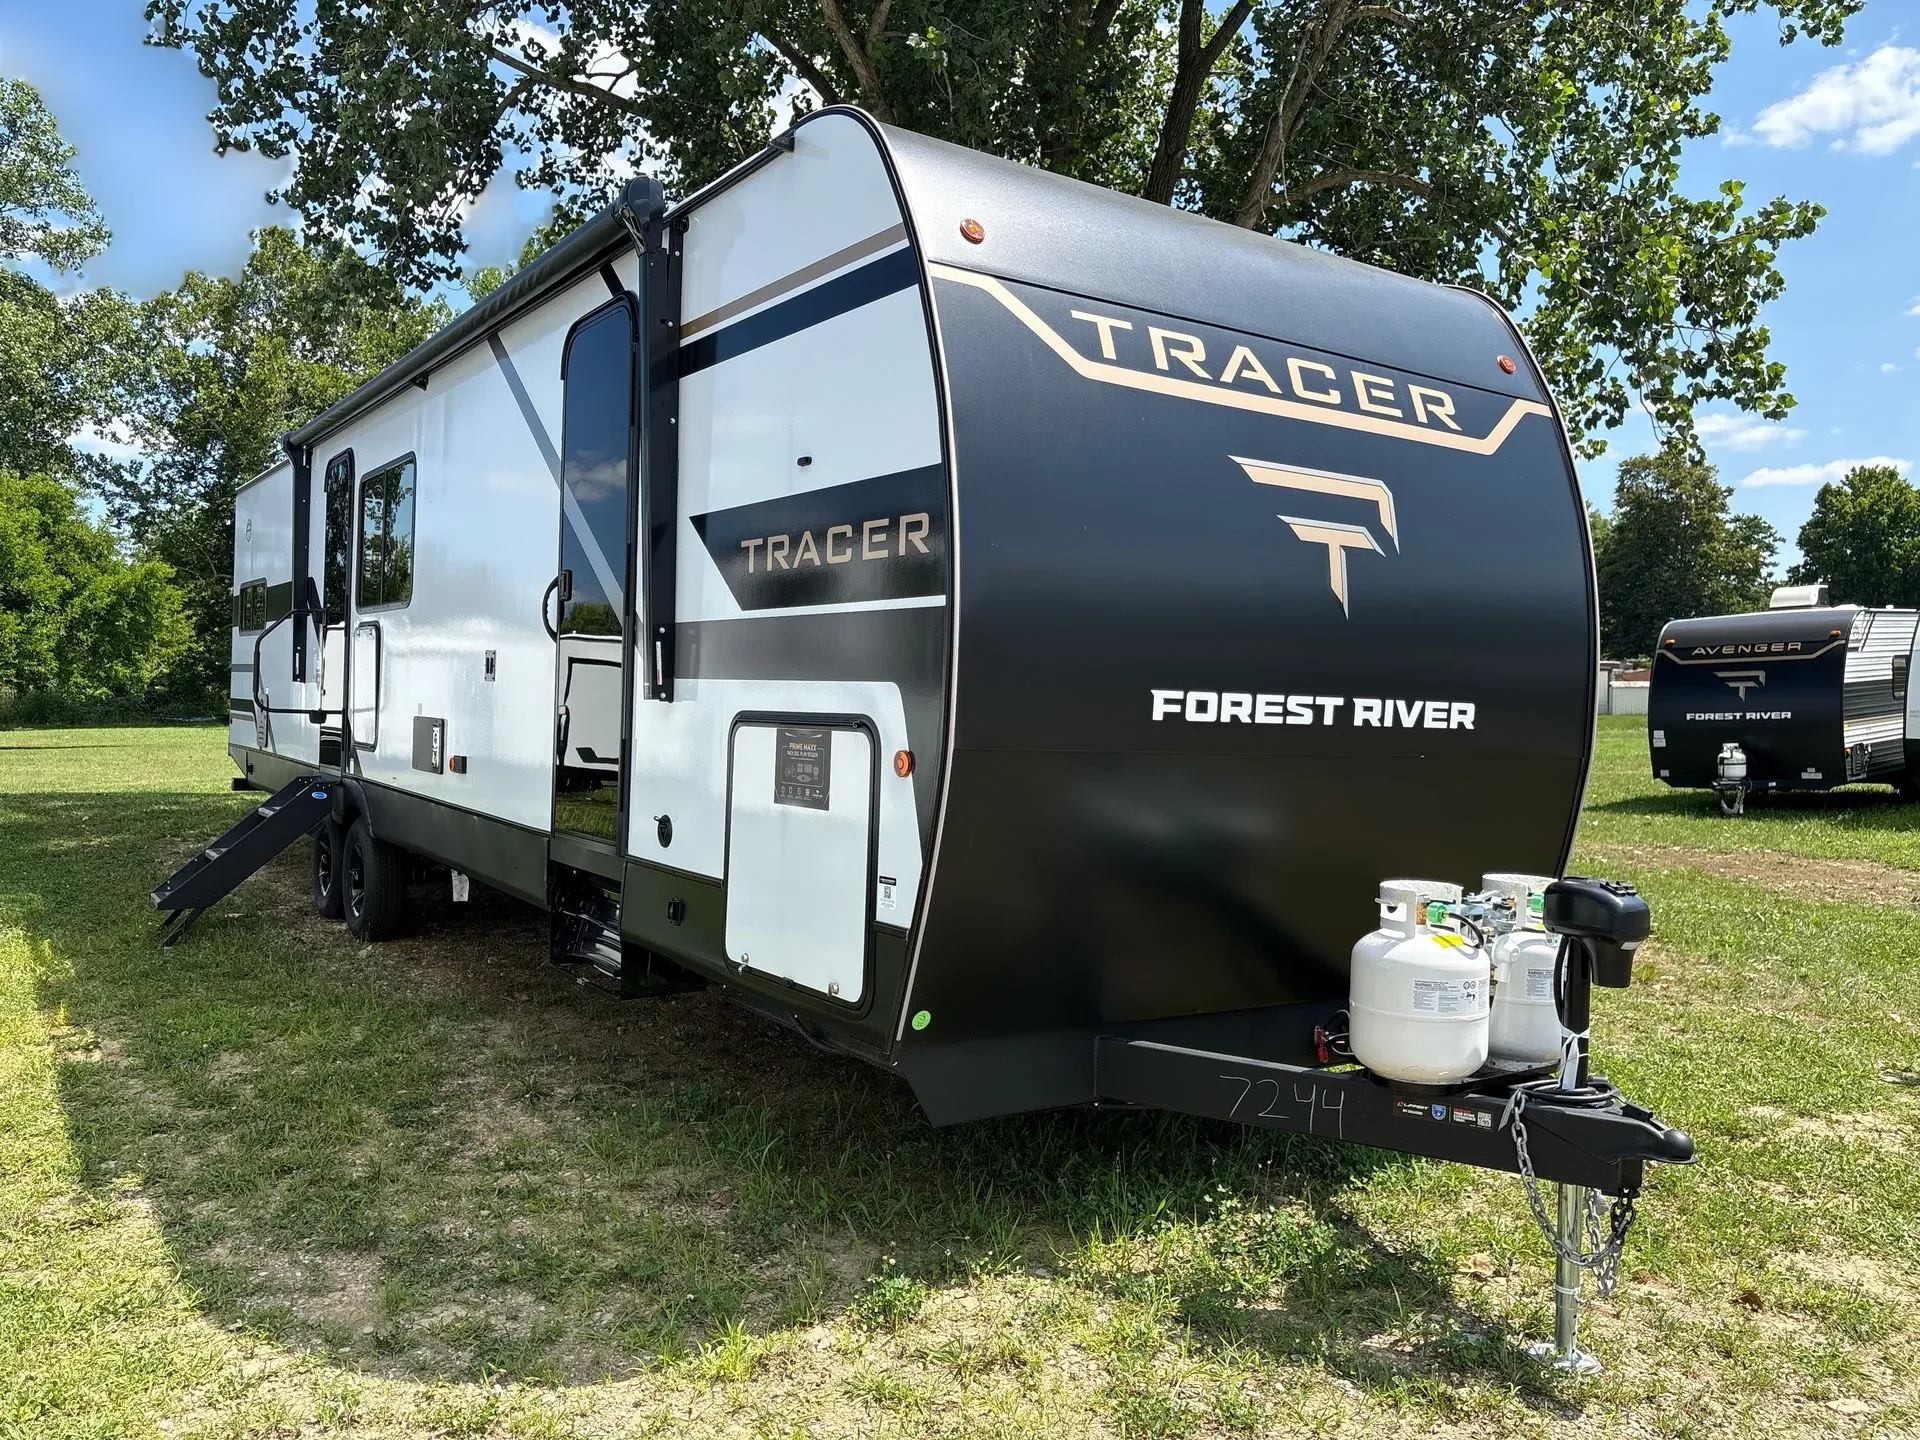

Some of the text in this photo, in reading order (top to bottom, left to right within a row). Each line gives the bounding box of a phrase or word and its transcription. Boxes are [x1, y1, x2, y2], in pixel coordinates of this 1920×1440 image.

[1070, 309, 1463, 431] TRACER
[741, 512, 930, 574] TRACER
[1691, 641, 1802, 656] AVENGER
[1151, 689, 1476, 730] FOREST RIVER
[1686, 711, 1792, 721] FOREST RIVER
[1219, 1075, 1344, 1140] 7244
